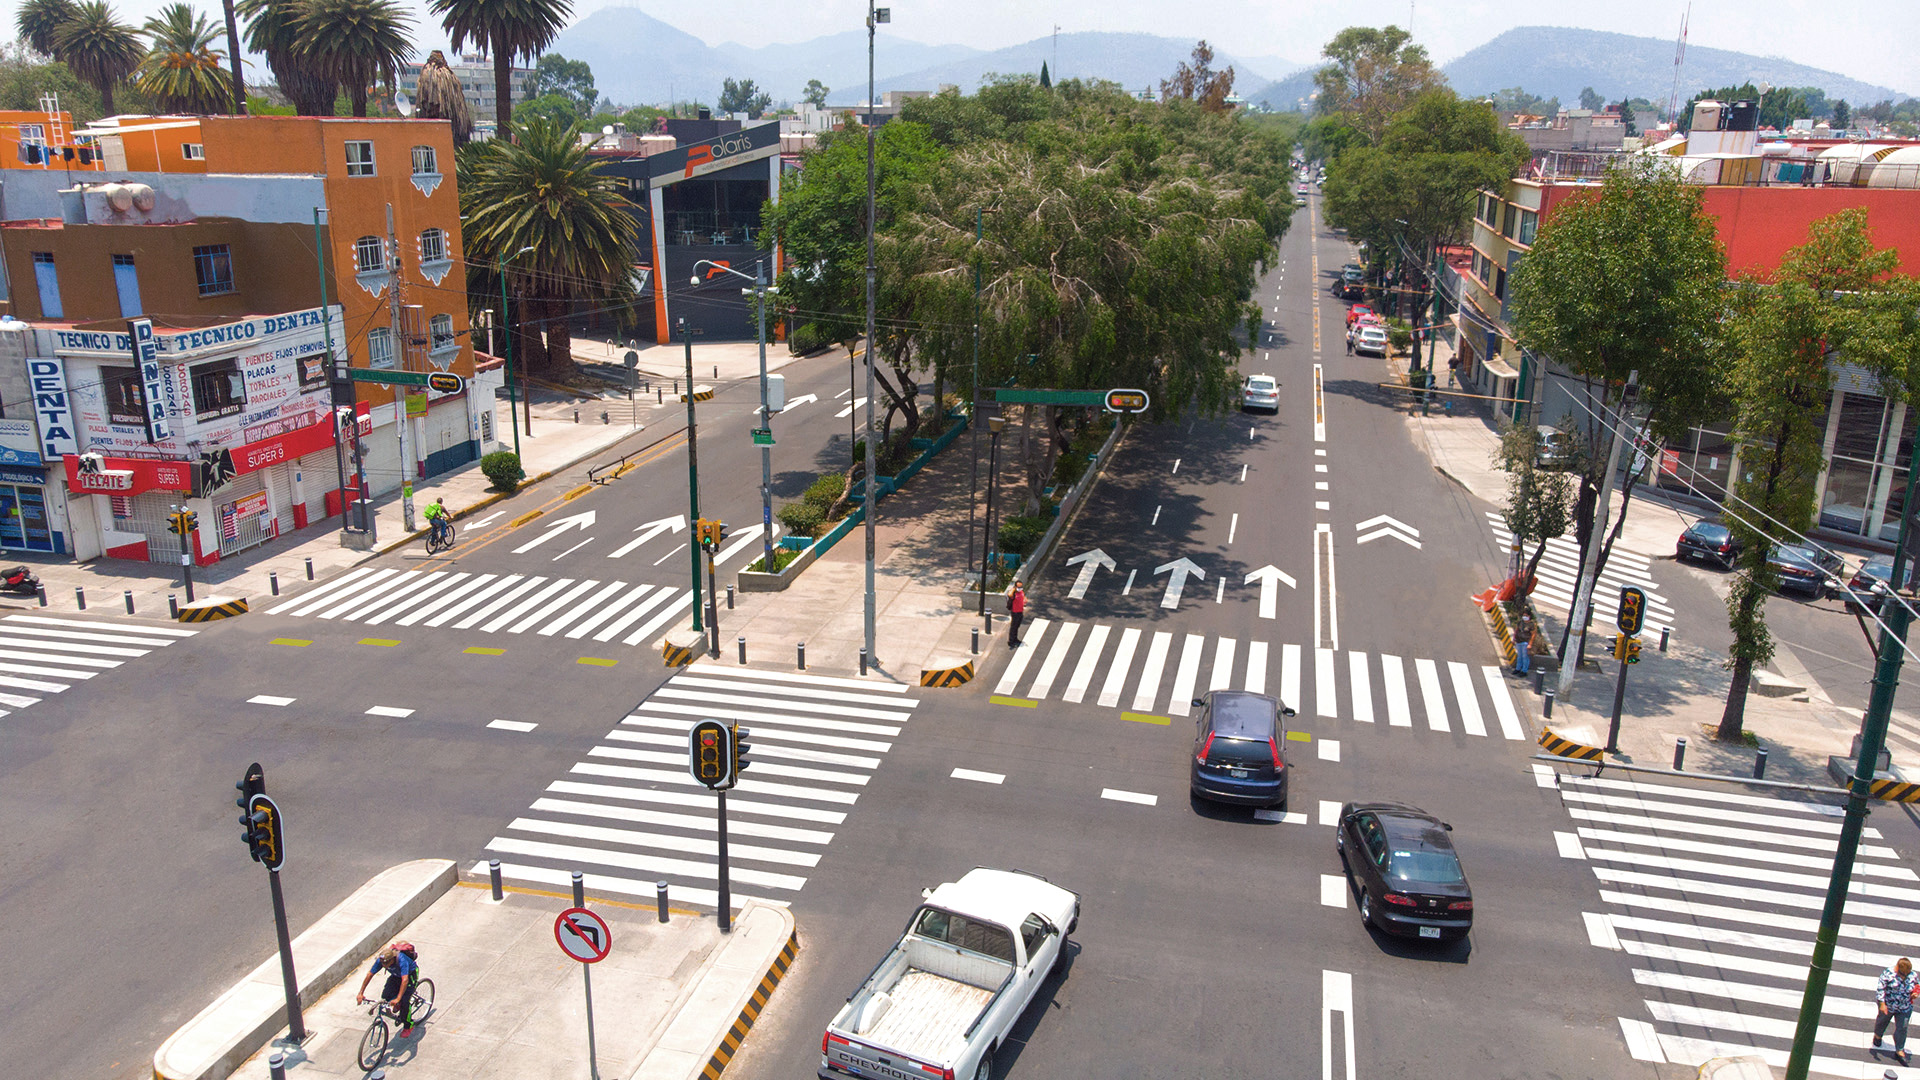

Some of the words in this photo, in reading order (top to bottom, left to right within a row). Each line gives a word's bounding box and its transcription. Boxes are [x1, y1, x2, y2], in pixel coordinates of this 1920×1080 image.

[684, 134, 752, 179] Polaris
[175, 322, 256, 351] TECNICO
[263, 309, 334, 334] DENTAL
[57, 332, 111, 349] TECNICO
[246, 353, 274, 366] PUENTES
[275, 348, 293, 359] FIJOS
[299, 338, 336, 354] REMOVIBLS
[247, 364, 276, 379] PLACAS
[137, 324, 169, 439] DENTAL
[162, 366, 176, 416] CORONAS
[177, 363, 192, 416] CORONAS
[249, 375, 281, 392] TOTALES
[250, 388, 288, 405] PARCIALES
[31, 362, 77, 457] DENTAL
[220, 405, 240, 415] GRATIS
[88, 424, 108, 433] PLACAS
[111, 426, 134, 434] TOTALES
[341, 418, 371, 440] TECTE
[90, 436, 113, 445] PUENTES
[248, 450, 277, 468] SUPER
[278, 447, 284, 459] 9
[80, 473, 125, 488] TECATE
[157, 473, 176, 485] SUPER
